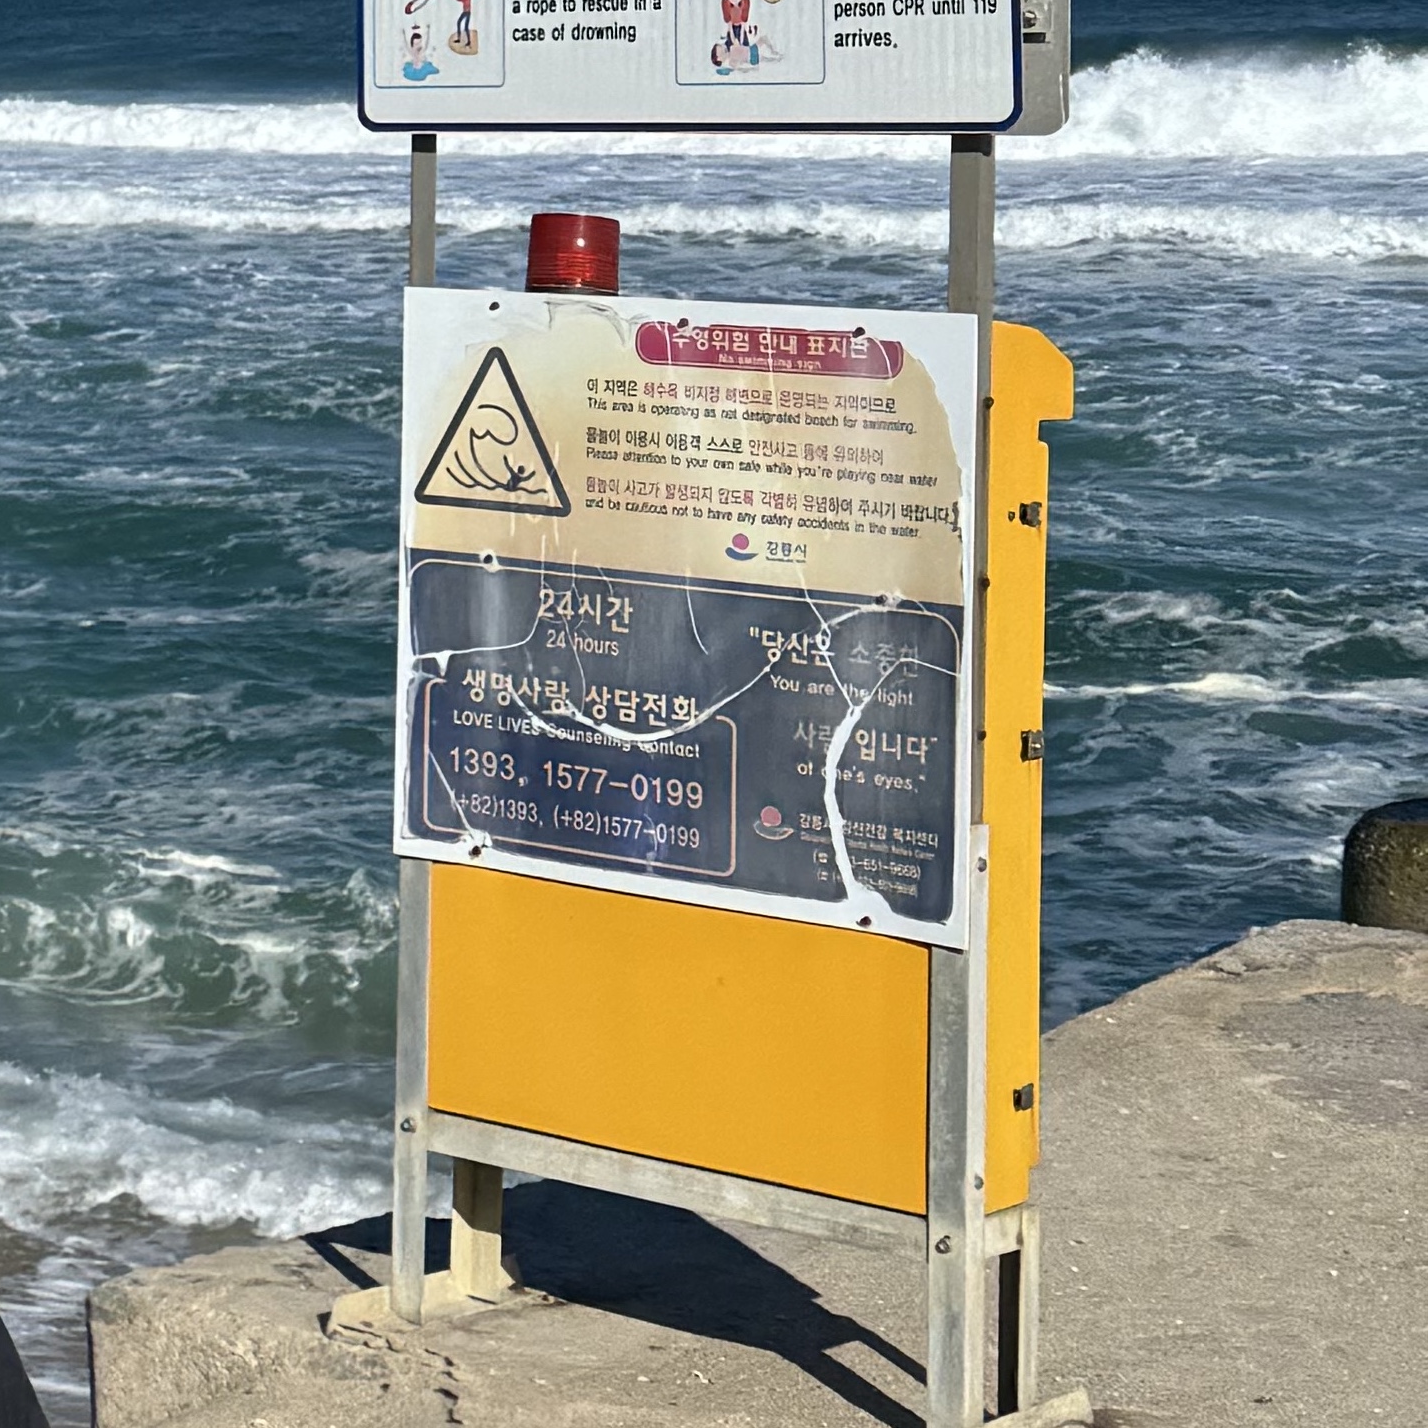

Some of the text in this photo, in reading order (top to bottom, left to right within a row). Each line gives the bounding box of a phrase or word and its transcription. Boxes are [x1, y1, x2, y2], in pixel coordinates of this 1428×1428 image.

[512, 0, 521, 14] a
[526, 0, 557, 16] rope
[834, 1, 885, 21] person
[512, 22, 636, 42] case of drowning
[834, 28, 898, 48] arrives.
[759, 331, 797, 355] 안내
[587, 378, 599, 394] 이
[684, 385, 720, 403] 비지정
[587, 397, 607, 411] This
[612, 402, 634, 412] area
[637, 402, 646, 413] is
[704, 408, 716, 418] as
[843, 415, 858, 428] for
[626, 430, 660, 448] 이용시
[706, 436, 743, 454] 스스로
[671, 455, 681, 466] to
[686, 456, 708, 468] your
[624, 479, 660, 498] 사고가
[858, 499, 895, 520] 주시기
[672, 505, 688, 516] not
[693, 507, 703, 518] to
[707, 507, 733, 521] have
[737, 511, 756, 525] any
[538, 588, 633, 633] 24시간
[546, 629, 619, 656] 24 hours
[462, 669, 699, 727] 생명사랑 상담전화
[770, 674, 800, 693] You
[807, 682, 835, 696] are
[877, 689, 913, 707] light
[453, 709, 493, 729] LOVE
[498, 716, 541, 736] LIVES
[450, 747, 703, 809] 1393, 1577-0199
[797, 761, 813, 776] of
[553, 805, 700, 849] (+82)1577-0199
